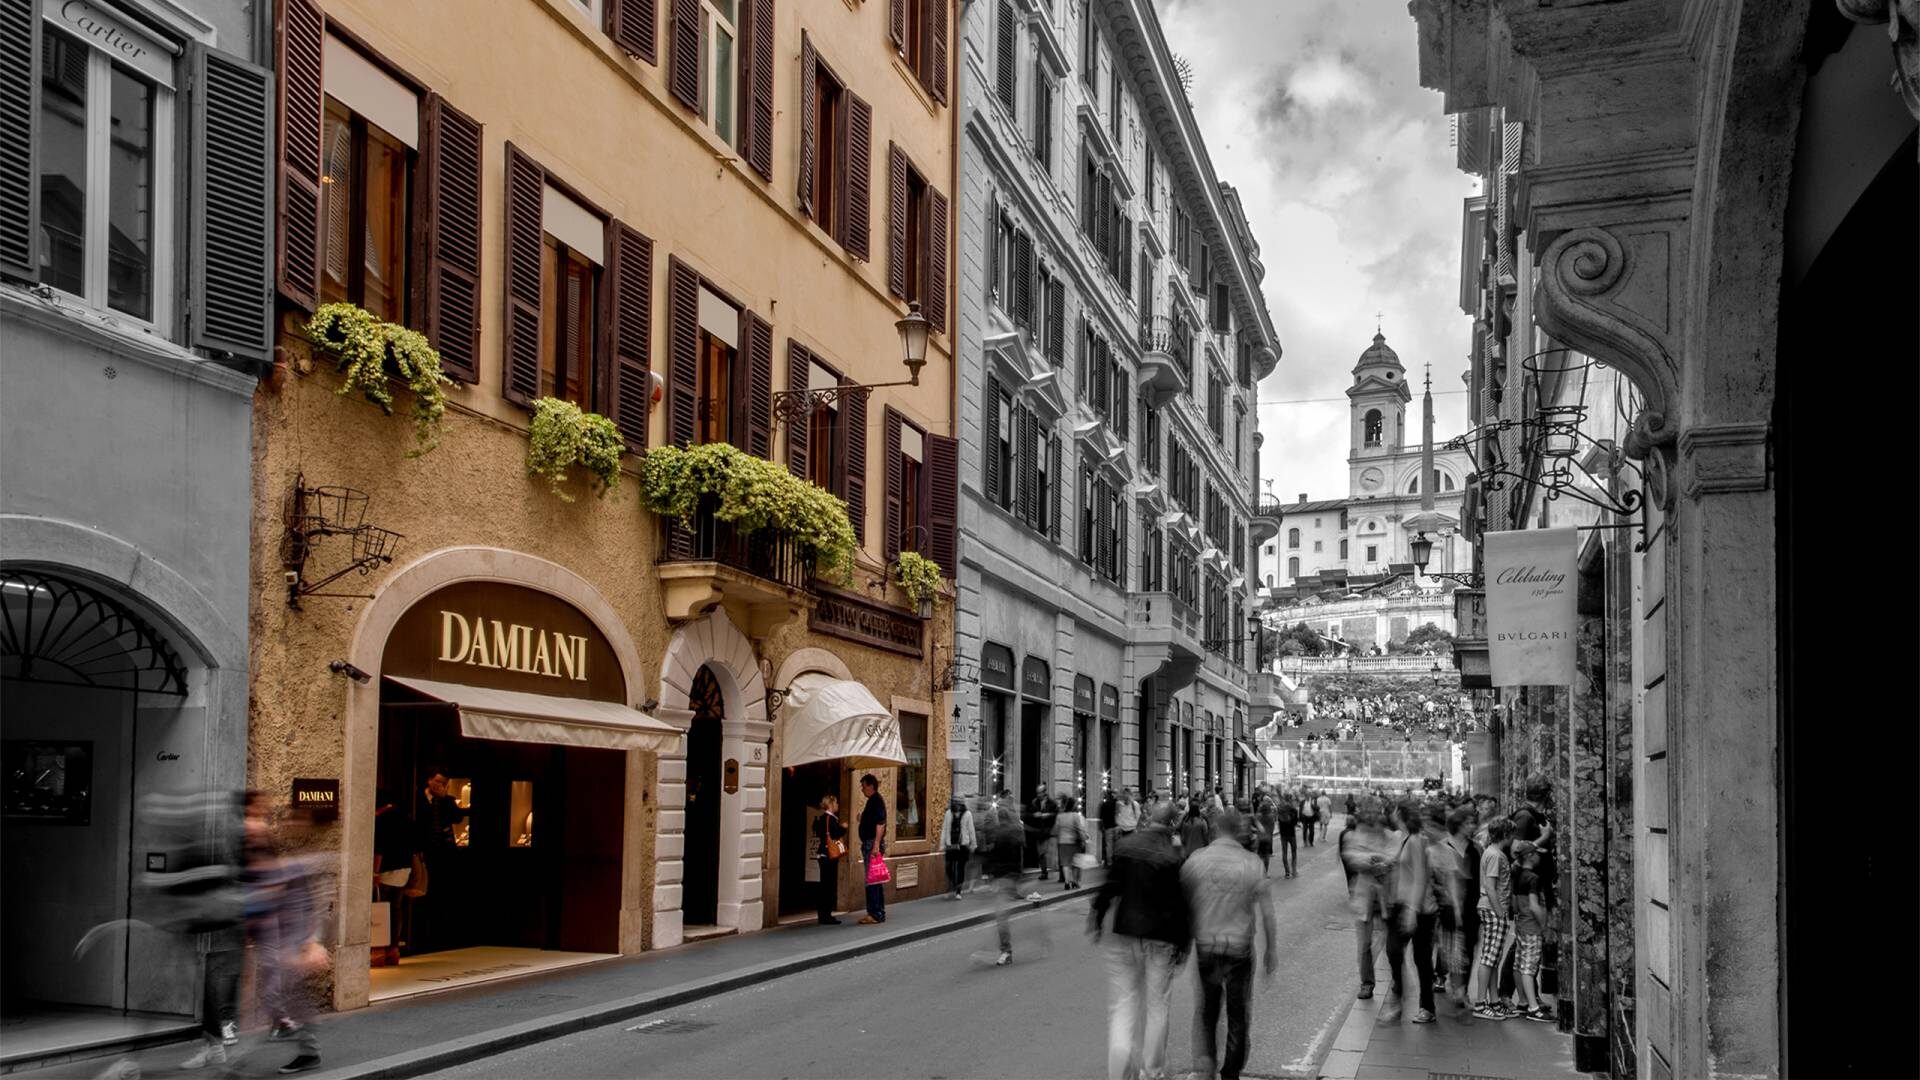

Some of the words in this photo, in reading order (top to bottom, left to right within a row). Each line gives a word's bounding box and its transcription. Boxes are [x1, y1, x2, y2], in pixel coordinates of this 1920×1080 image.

[61, 0, 147, 58] Cartier
[1496, 566, 1566, 588] Celebrating
[438, 610, 588, 681] DAMIANI
[1498, 631, 1568, 641] BVLGARI
[299, 791, 334, 801] DAMIANI
